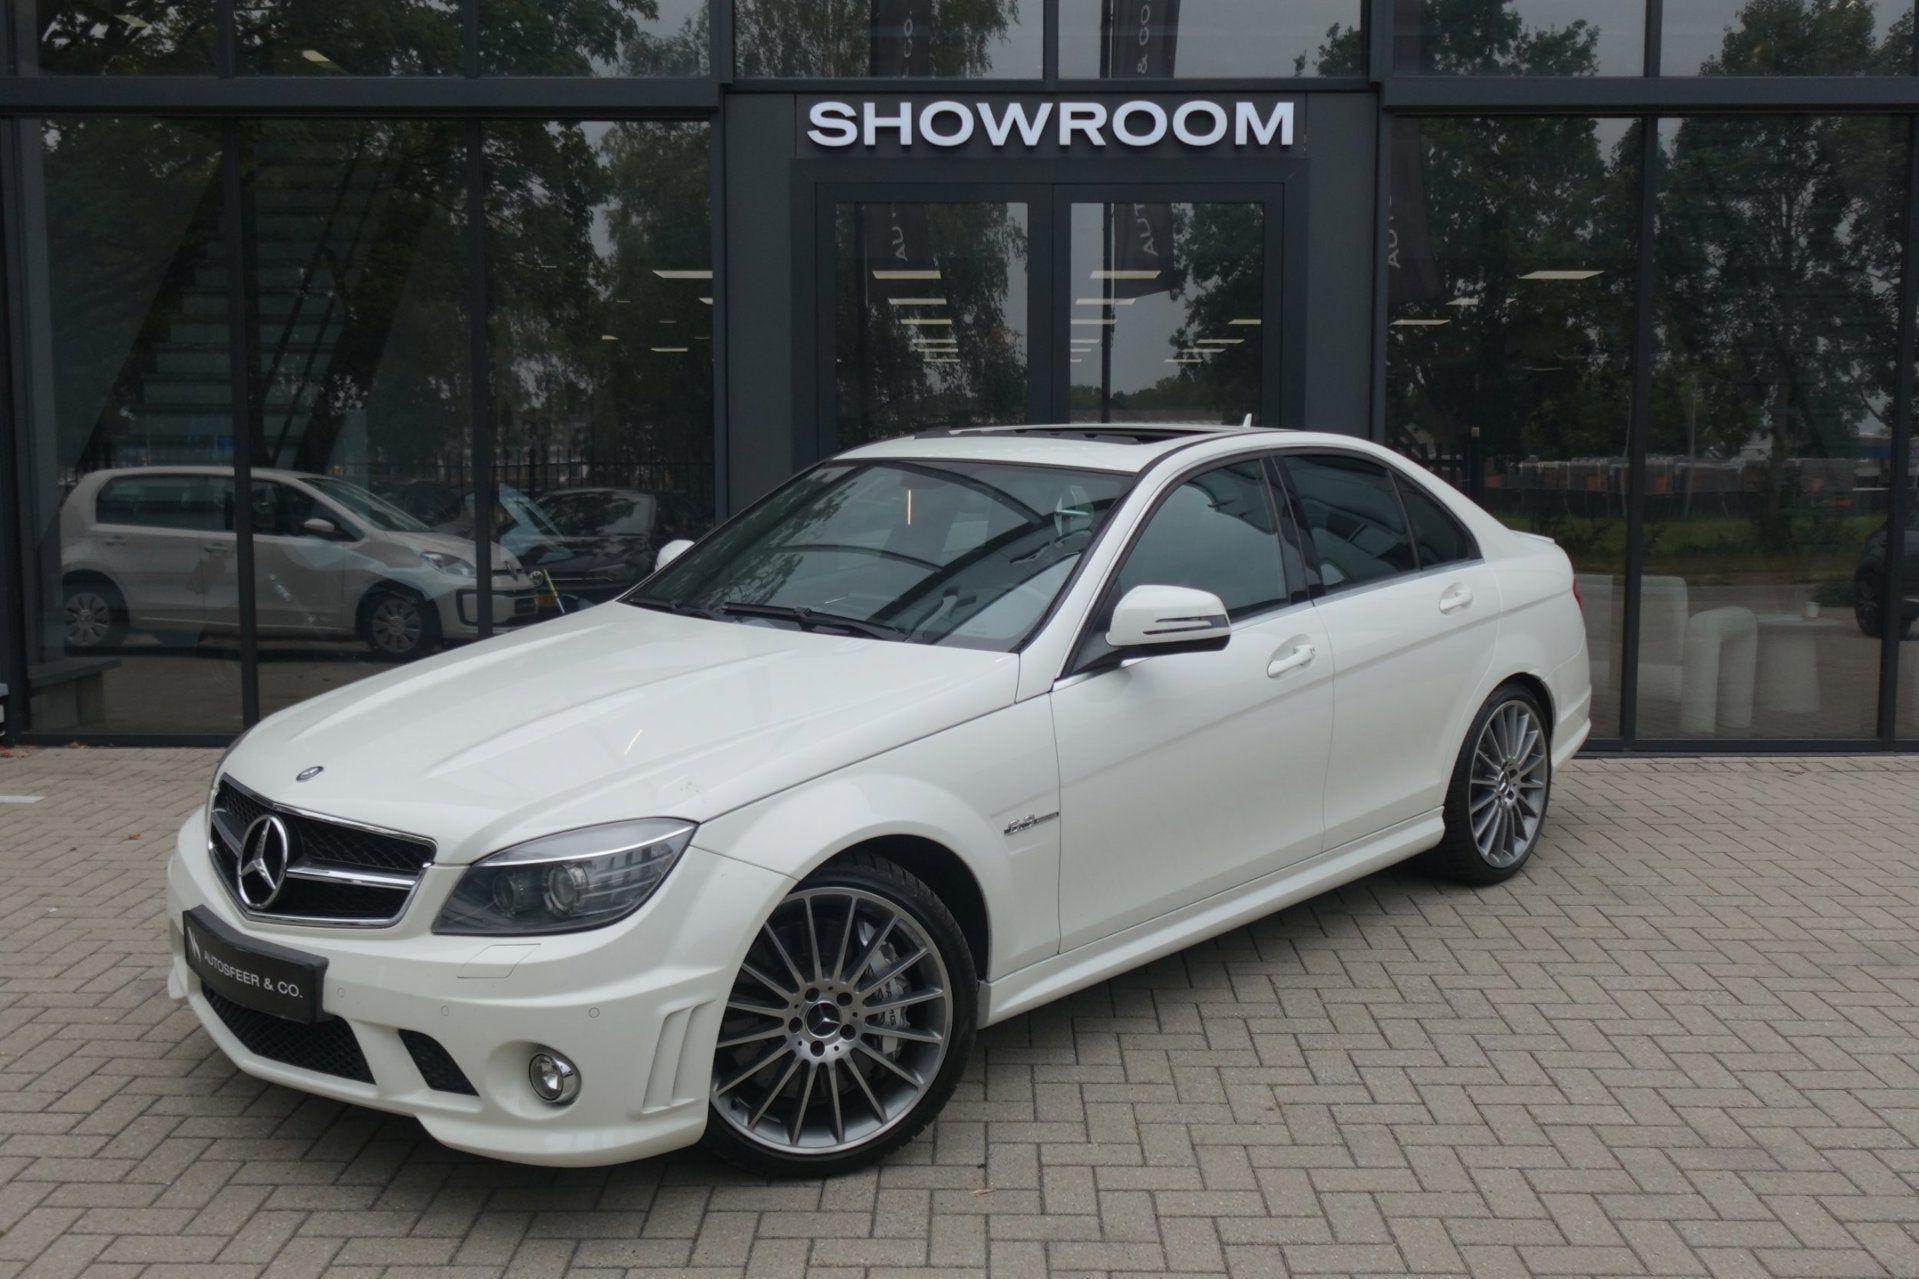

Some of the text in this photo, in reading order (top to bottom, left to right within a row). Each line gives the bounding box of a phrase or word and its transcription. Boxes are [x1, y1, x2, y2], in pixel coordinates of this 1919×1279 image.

[1139, 3, 1151, 47] CO
[806, 100, 1295, 147] SHOWROOM
[204, 950, 303, 999] AUTOSFEER & CO.
